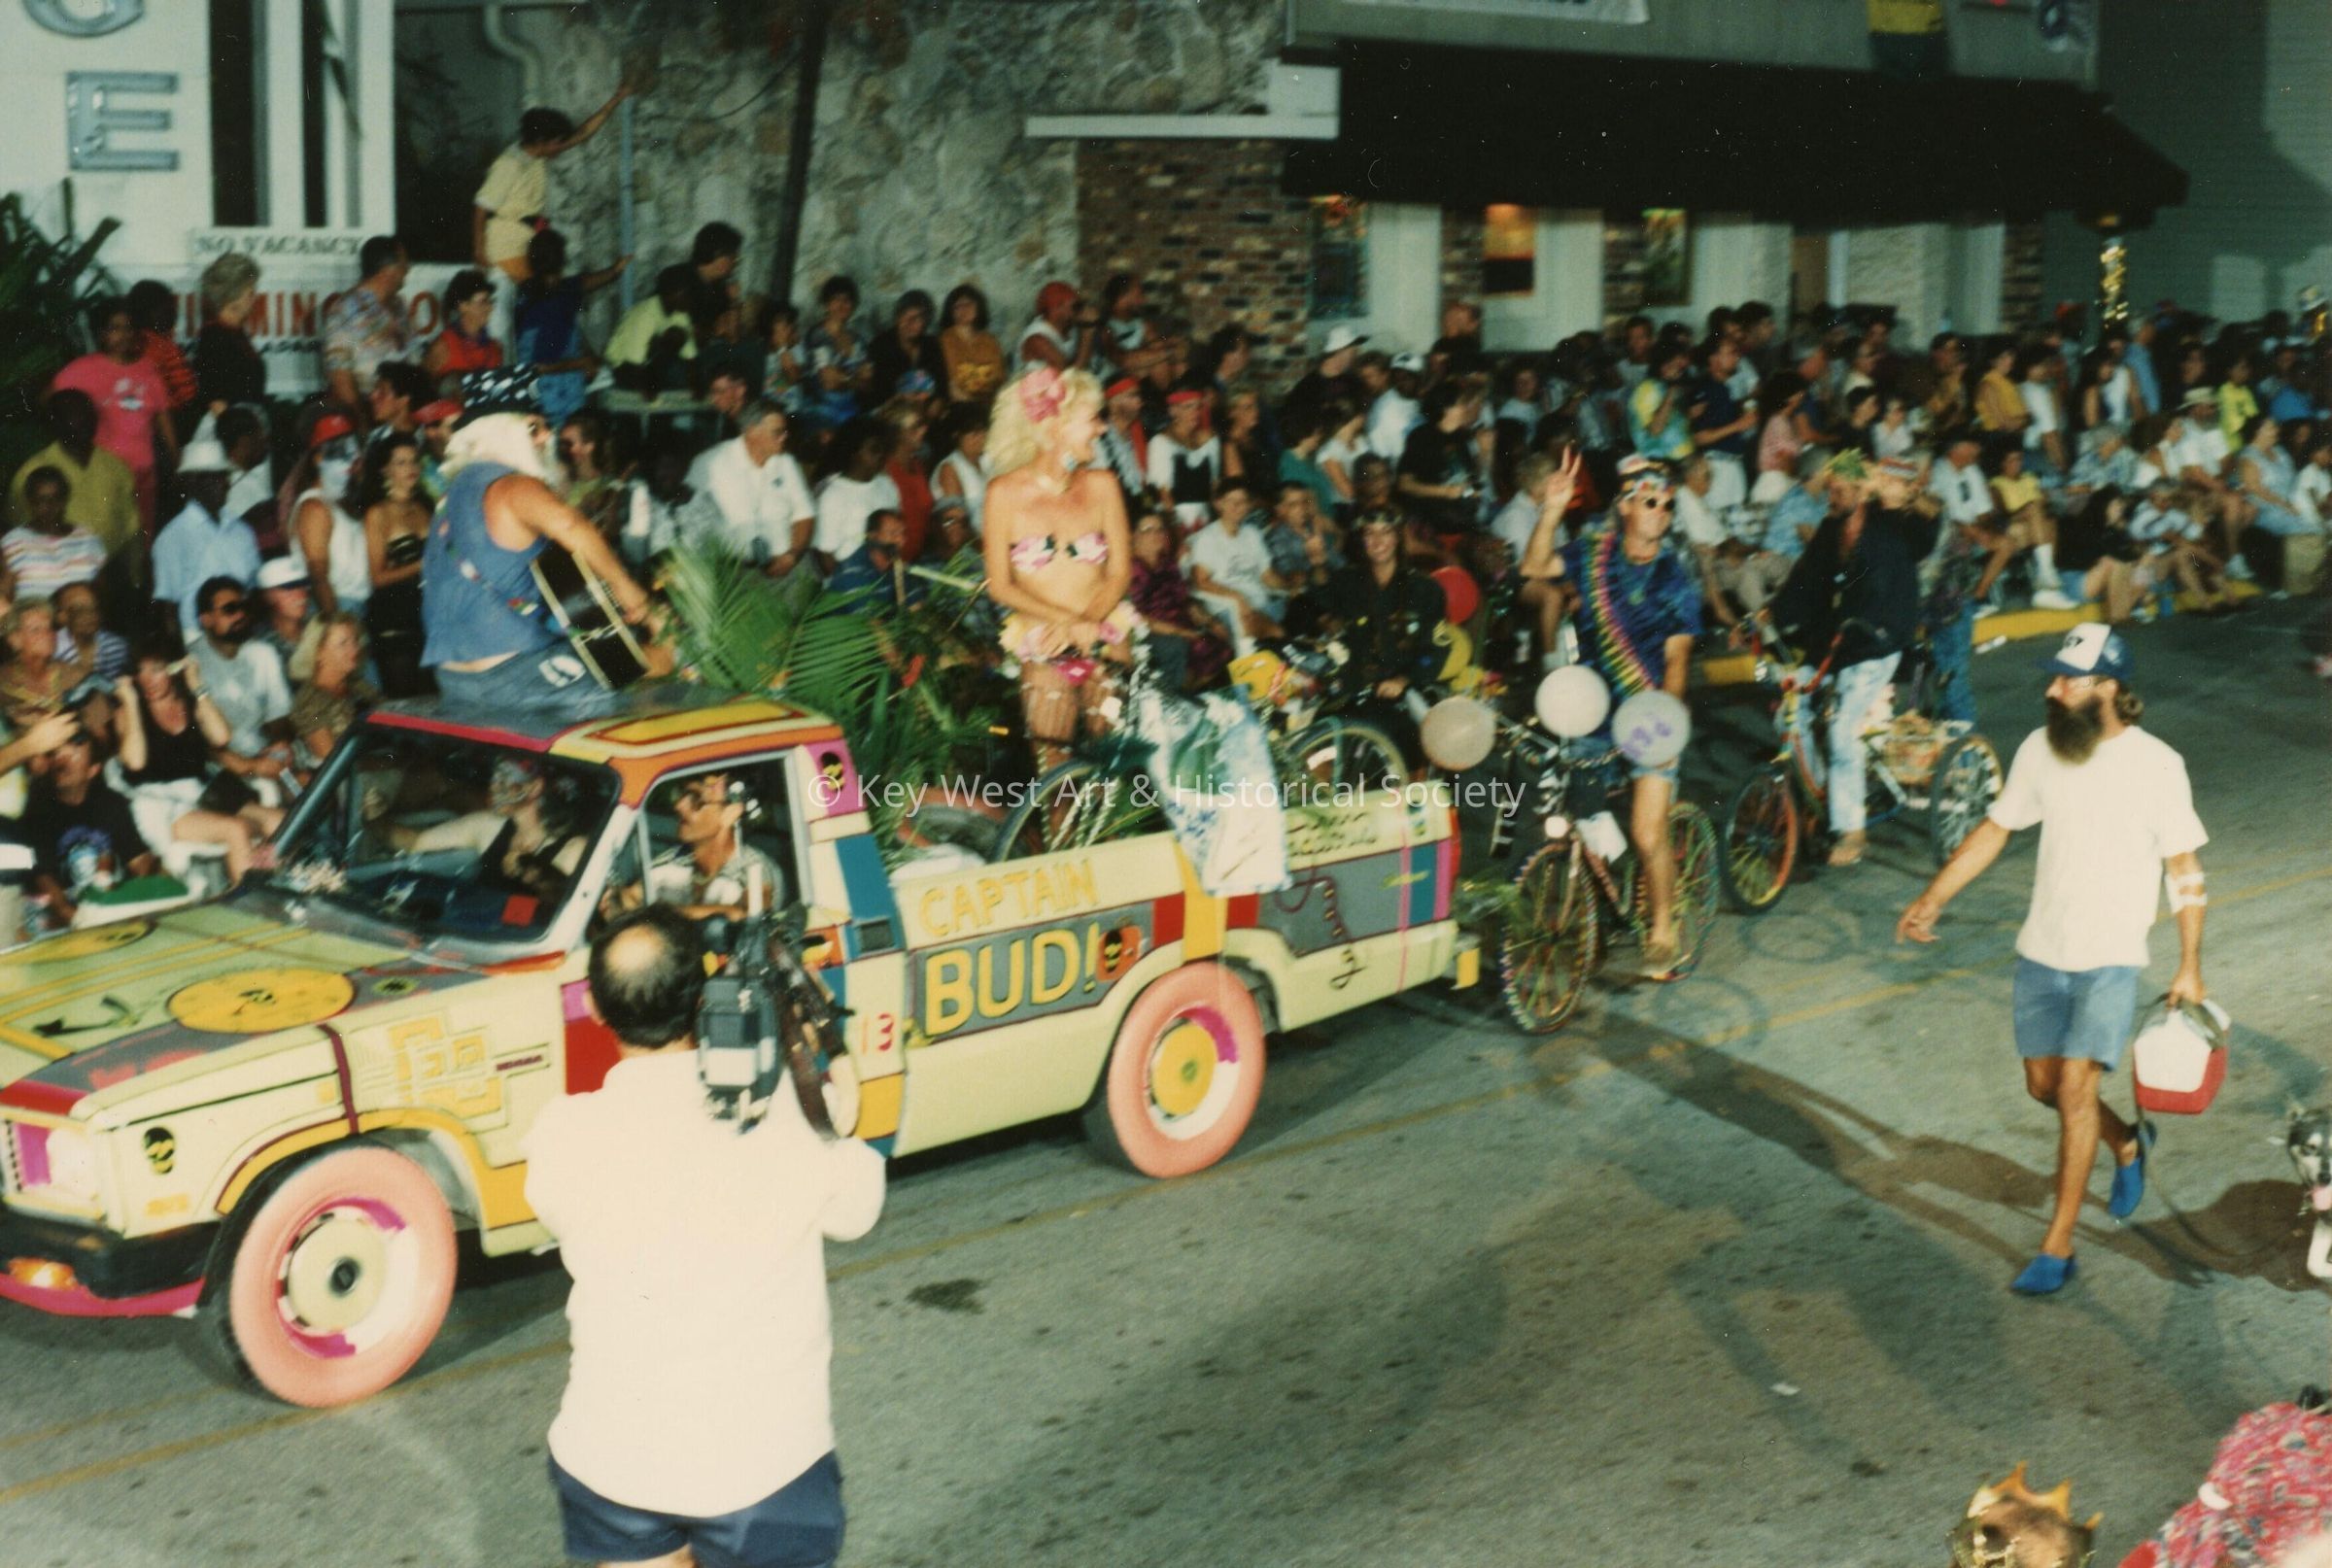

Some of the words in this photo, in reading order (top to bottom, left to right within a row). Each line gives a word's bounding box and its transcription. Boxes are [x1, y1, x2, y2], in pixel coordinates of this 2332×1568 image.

[196, 236, 235, 254] NO
[919, 857, 1099, 937] CAPTAIN
[925, 923, 1101, 1037] BUD!
[861, 1012, 895, 1054] 13
